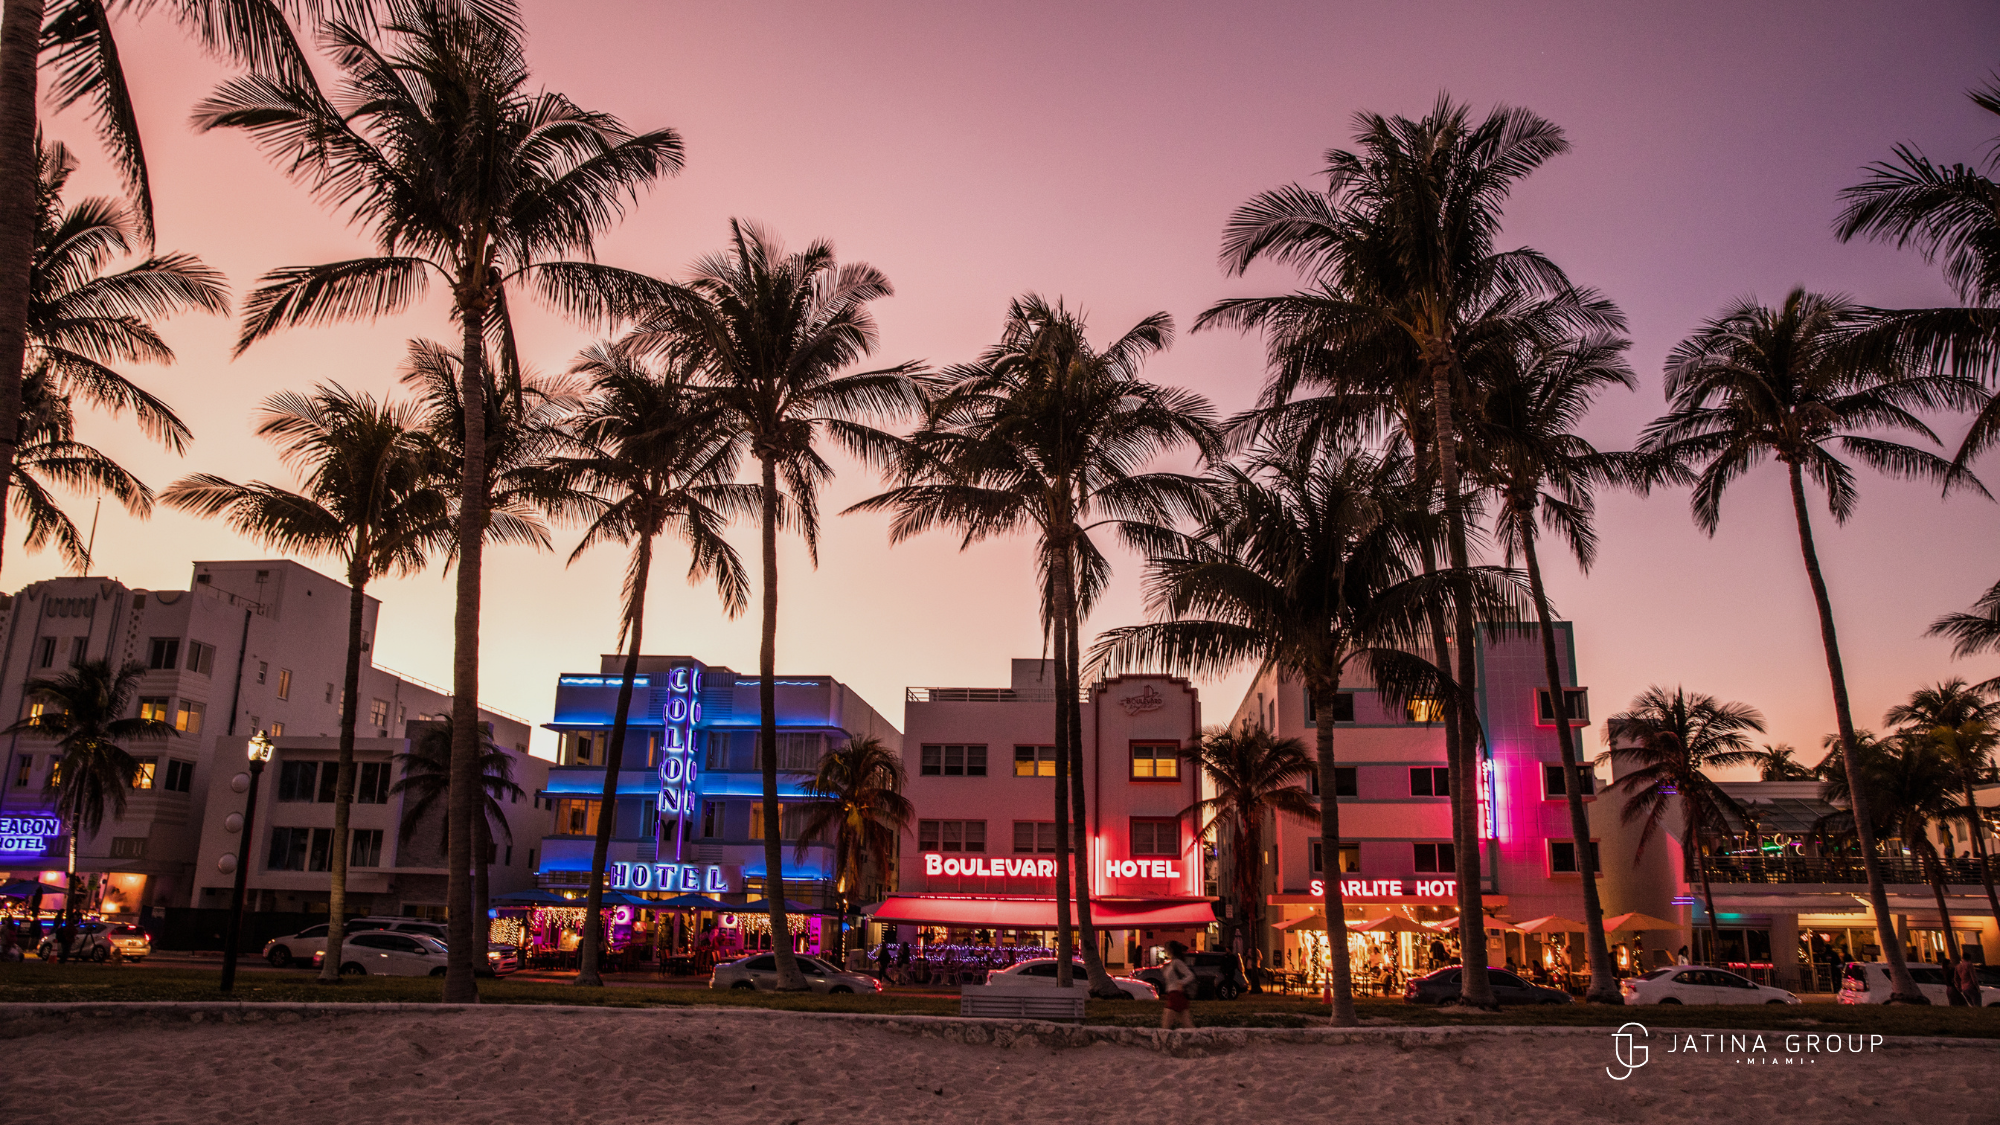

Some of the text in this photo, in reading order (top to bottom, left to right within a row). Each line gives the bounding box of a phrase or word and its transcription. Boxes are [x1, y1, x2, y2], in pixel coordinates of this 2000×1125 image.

[661, 666, 689, 842] COLONY
[0, 818, 60, 836] EACON
[610, 862, 728, 892] HOTEL
[1105, 859, 1181, 878] HOTEL
[1310, 880, 1457, 897] SARLITE HOT
